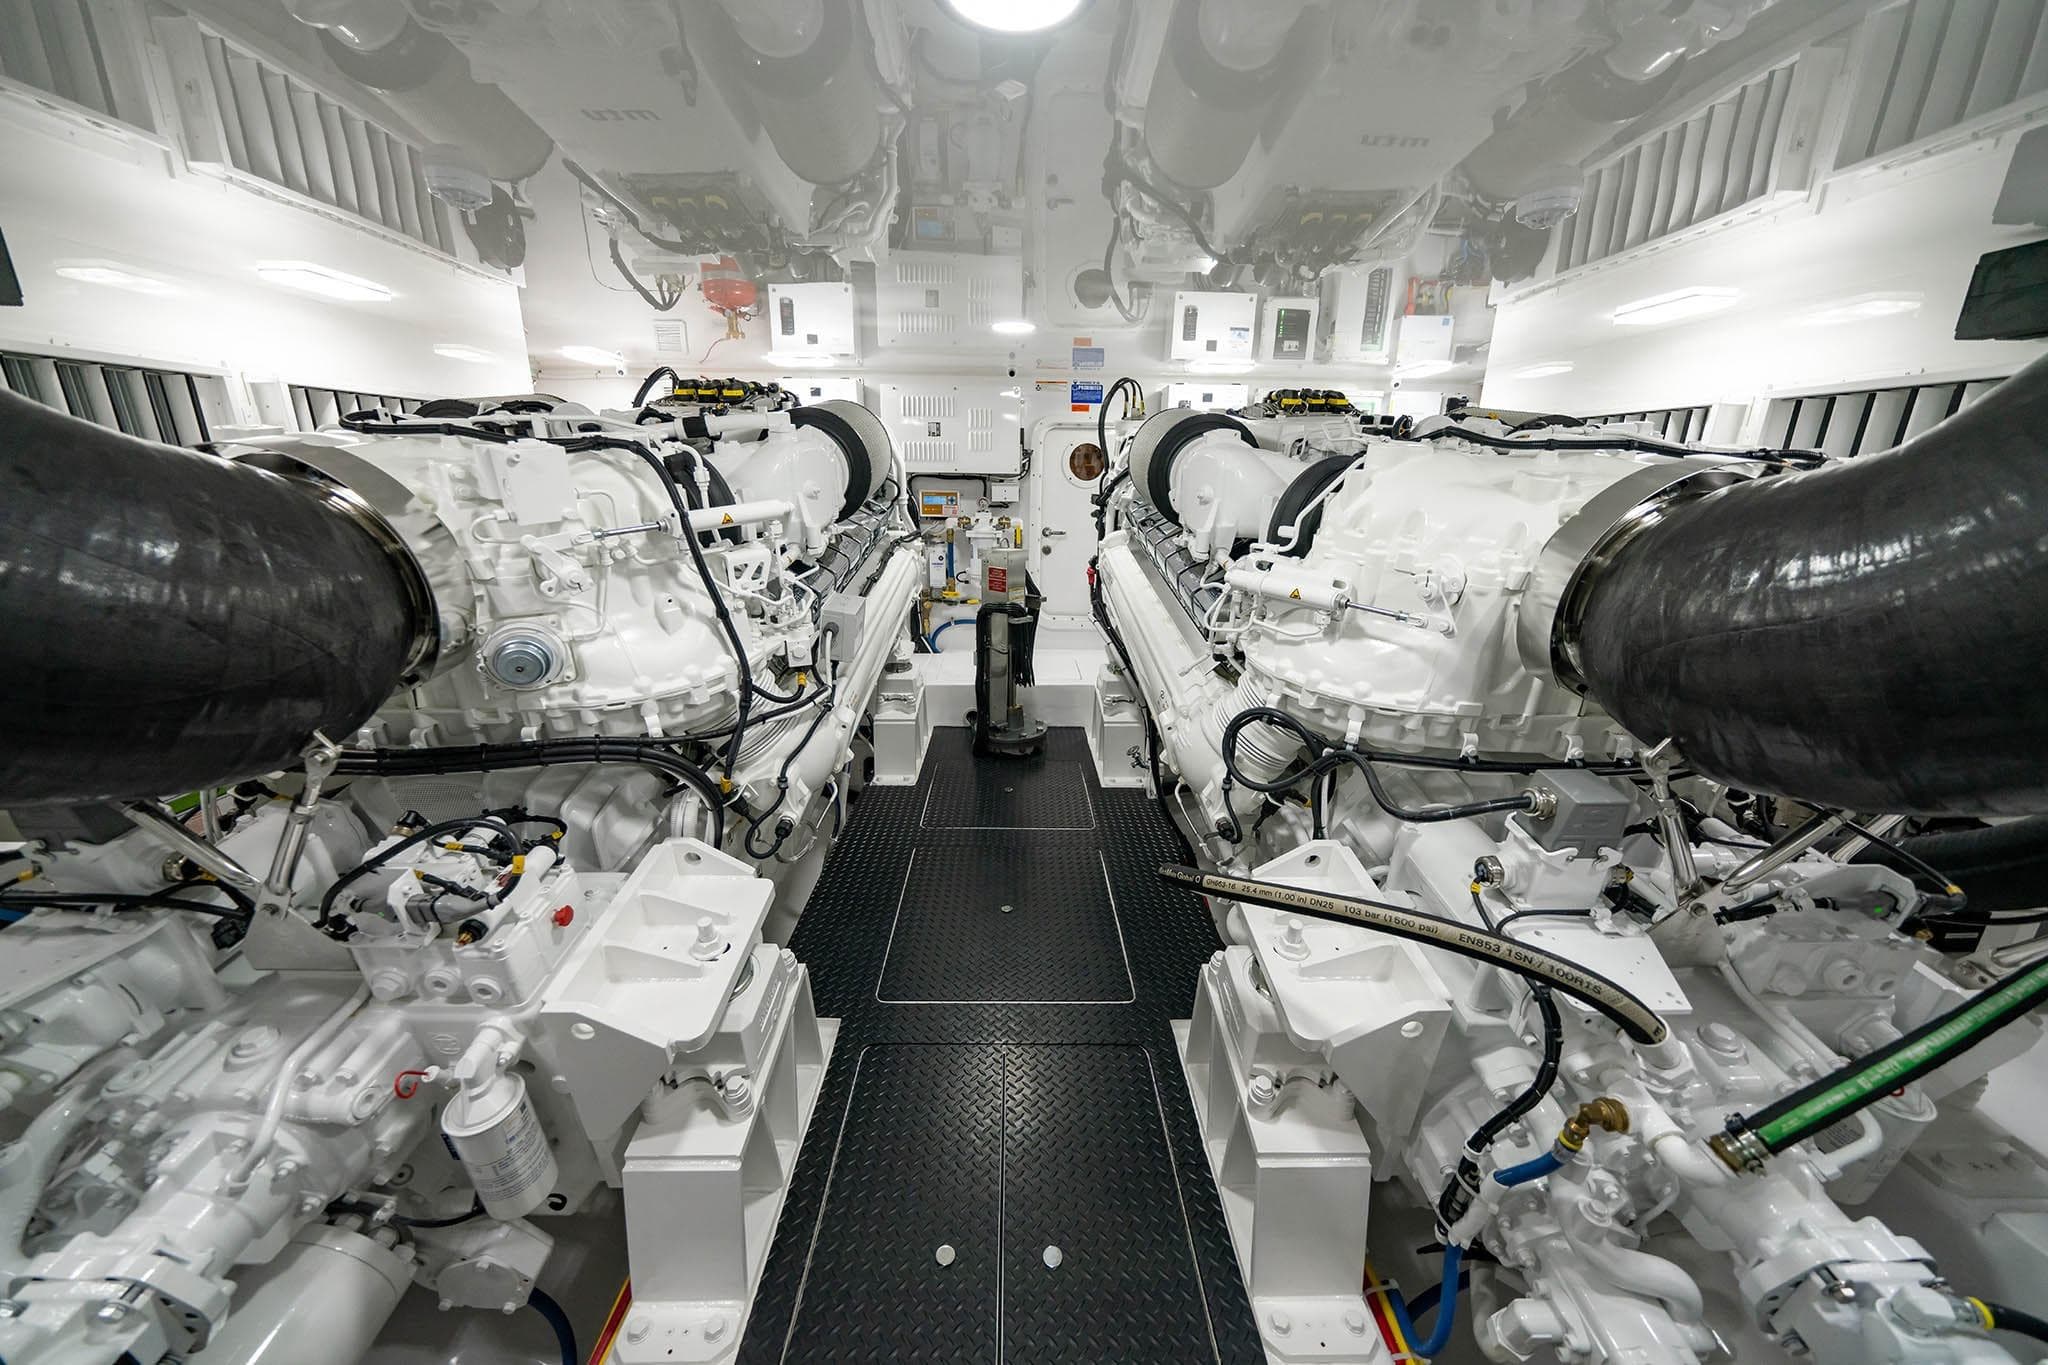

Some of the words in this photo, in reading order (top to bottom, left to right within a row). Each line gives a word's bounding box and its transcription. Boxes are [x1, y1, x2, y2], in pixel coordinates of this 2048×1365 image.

[1241, 884, 1258, 894] 25.4
[1258, 888, 1273, 897] mm
[1274, 889, 1296, 902] (1.00
[1296, 893, 1307, 904] in)
[1309, 898, 1334, 910] DN25
[1344, 905, 1362, 916] 103
[1364, 908, 1380, 920] bar
[1383, 914, 1416, 929] (1500
[1418, 923, 1439, 935] psi)
[1458, 932, 1501, 954] EN853
[1507, 948, 1534, 966] 1SN
